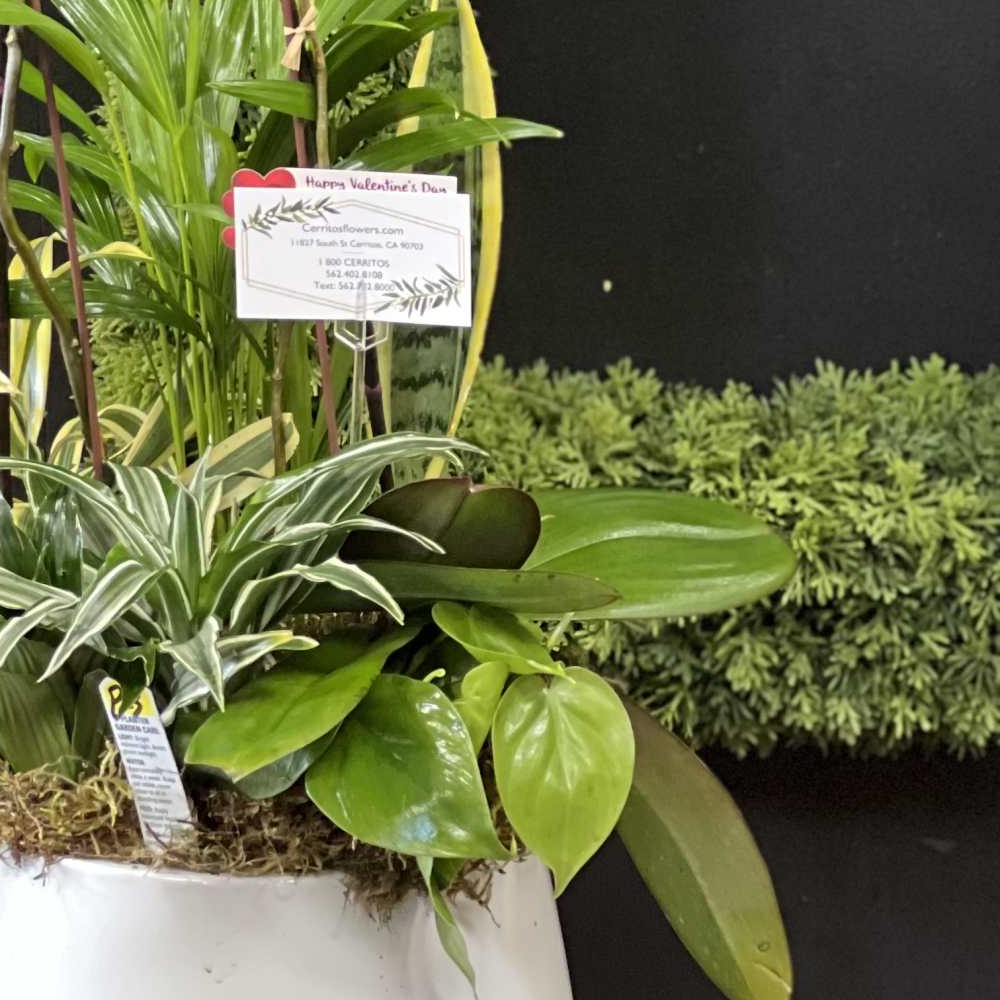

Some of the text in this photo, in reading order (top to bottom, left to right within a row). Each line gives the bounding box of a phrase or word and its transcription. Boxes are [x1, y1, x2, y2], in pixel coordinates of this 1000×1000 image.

[305, 175, 448, 194] Happy Valentine's Day
[302, 223, 404, 236] Cerritosflowers.com
[386, 241, 399, 249] CA
[325, 258, 342, 267] 800
[343, 258, 391, 268] CERRITOS
